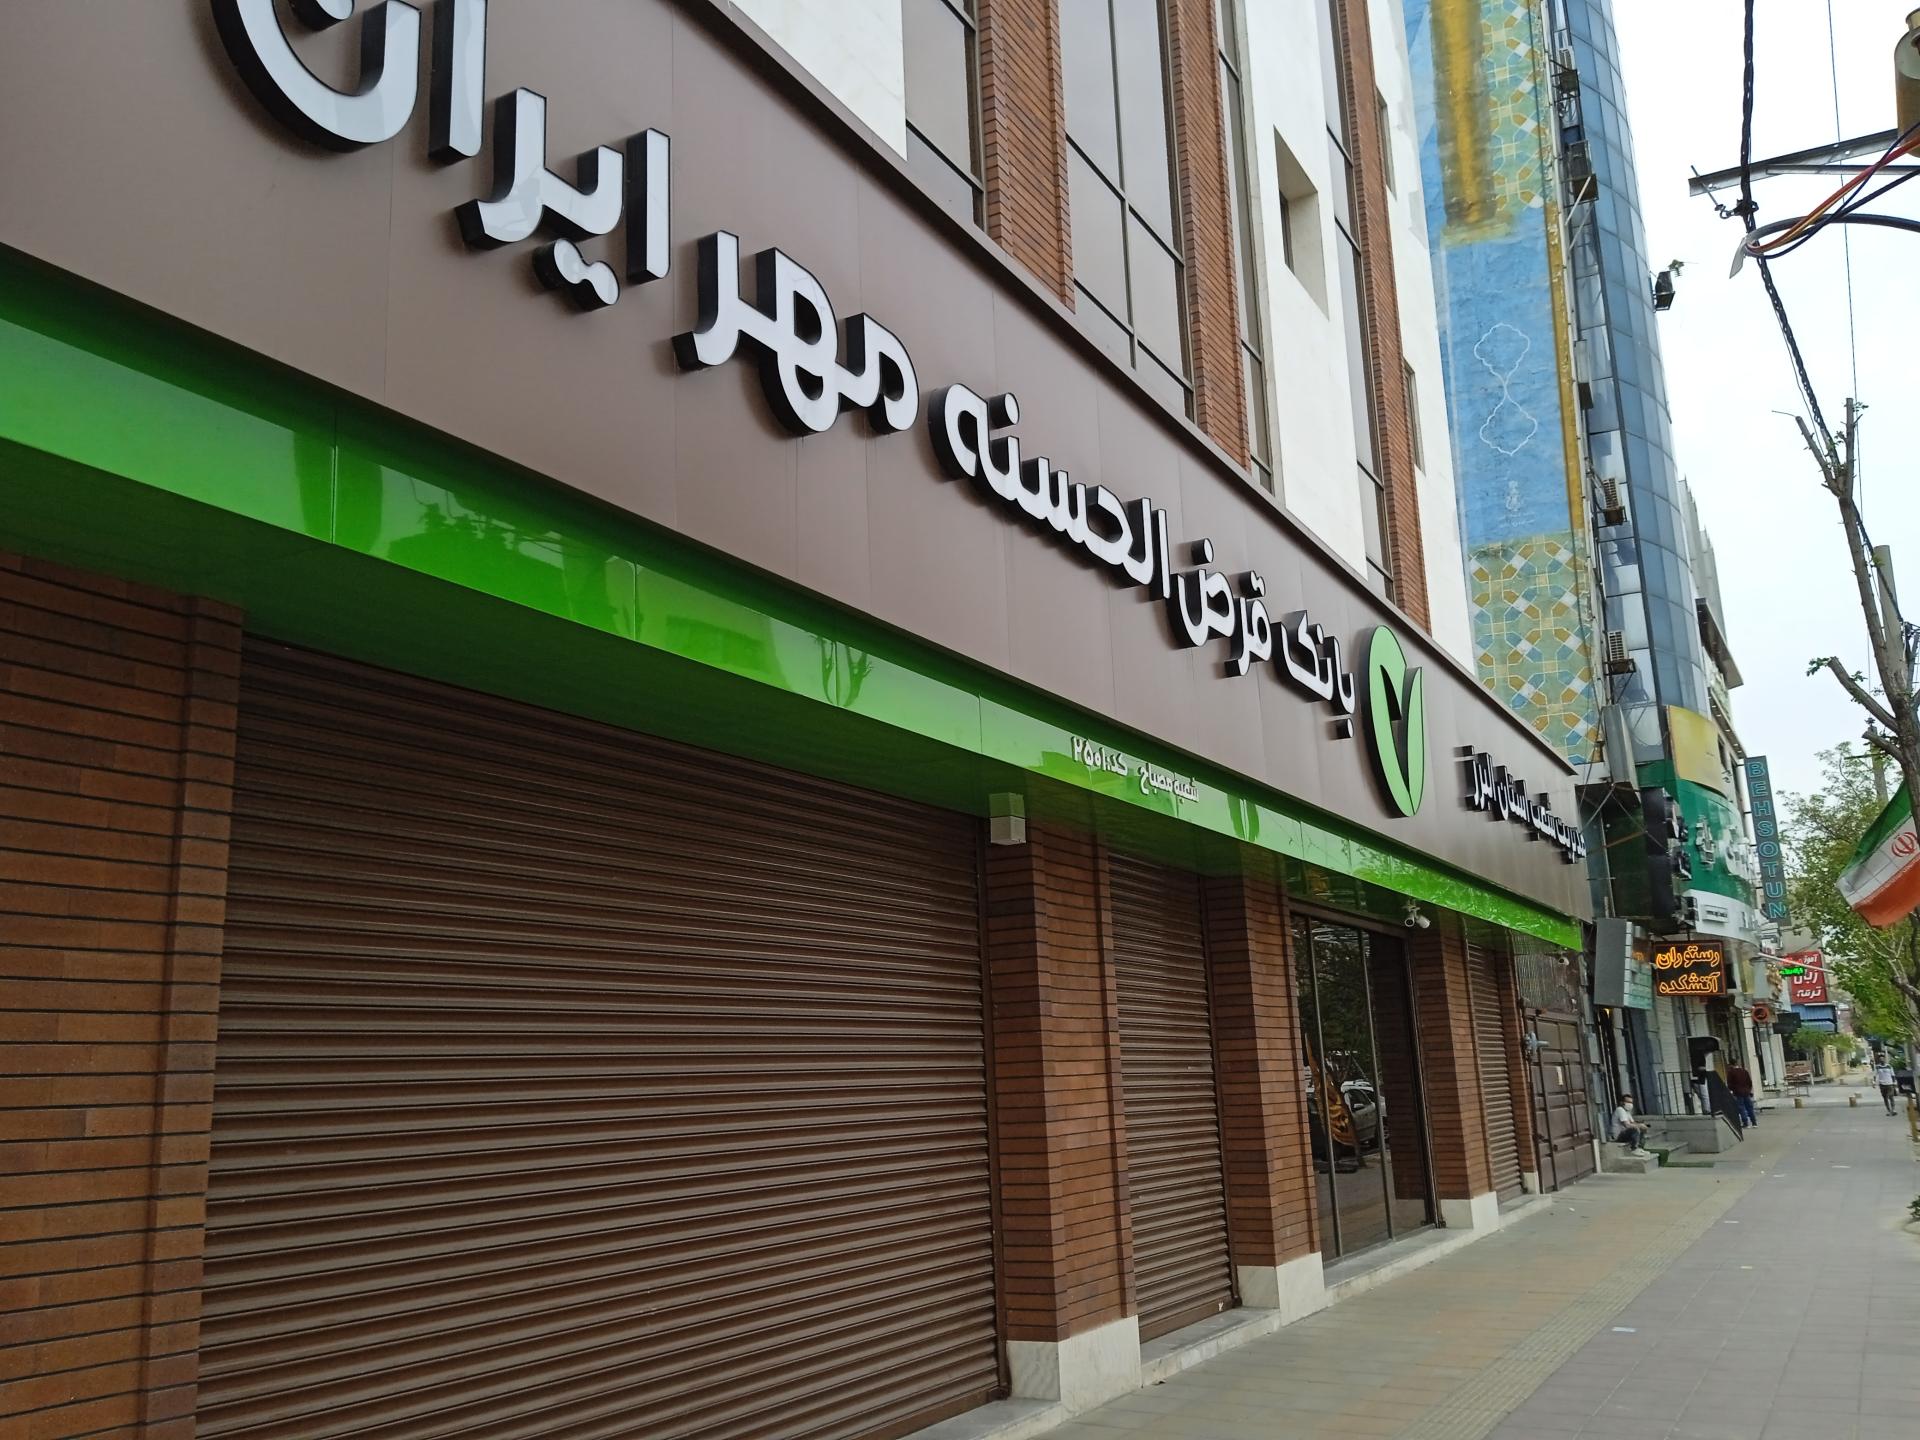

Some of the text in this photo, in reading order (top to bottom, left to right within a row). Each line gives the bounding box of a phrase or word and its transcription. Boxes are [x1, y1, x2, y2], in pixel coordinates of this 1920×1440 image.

[213, 0, 1355, 738] بانک قرض الحسنه مهر ایران
[1138, 762, 1174, 795] مصباح
[1465, 745, 1497, 811] البرز
[1496, 766, 1531, 823] استان
[1747, 761, 1787, 919] BEHSOTUN
[1656, 945, 1720, 969] رستوران
[1659, 972, 1721, 993] آتشکده
